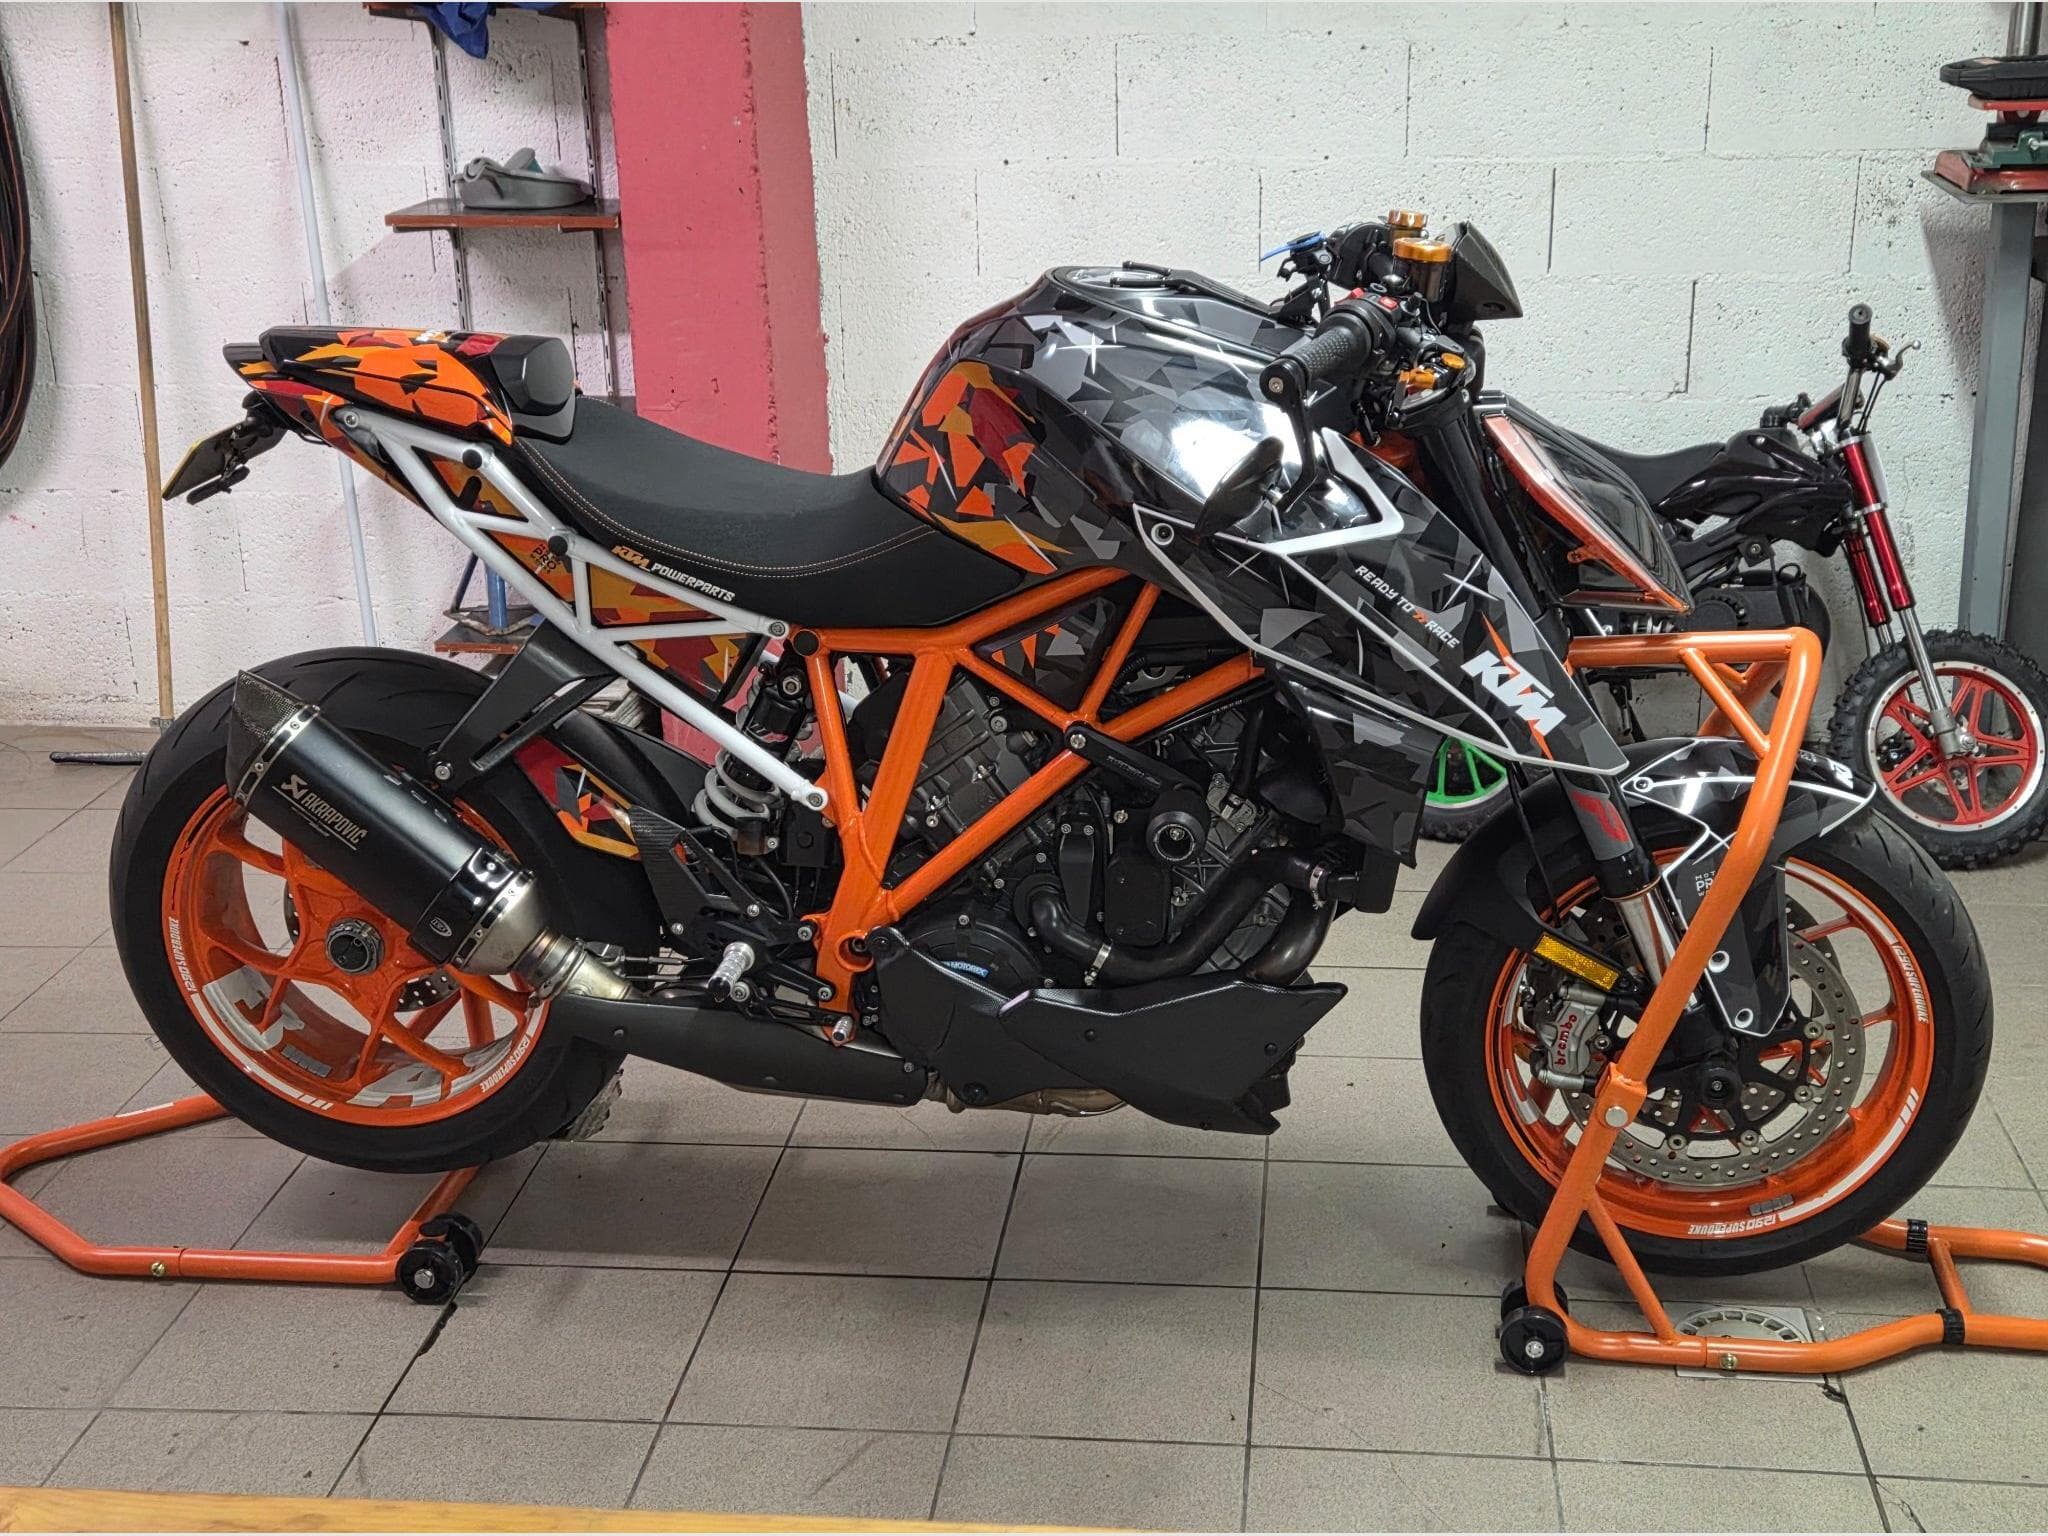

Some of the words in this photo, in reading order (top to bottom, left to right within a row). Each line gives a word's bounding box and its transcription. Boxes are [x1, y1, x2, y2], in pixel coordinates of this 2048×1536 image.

[611, 545, 651, 571] KTM
[651, 562, 736, 602] POWERPARTS
[1354, 564, 1399, 600] READY
[1396, 596, 1416, 613] TO
[1424, 620, 1460, 649] RACE
[1460, 650, 1567, 736] KTM
[1695, 877, 1714, 892] PR
[1554, 1014, 1578, 1066] brembo
